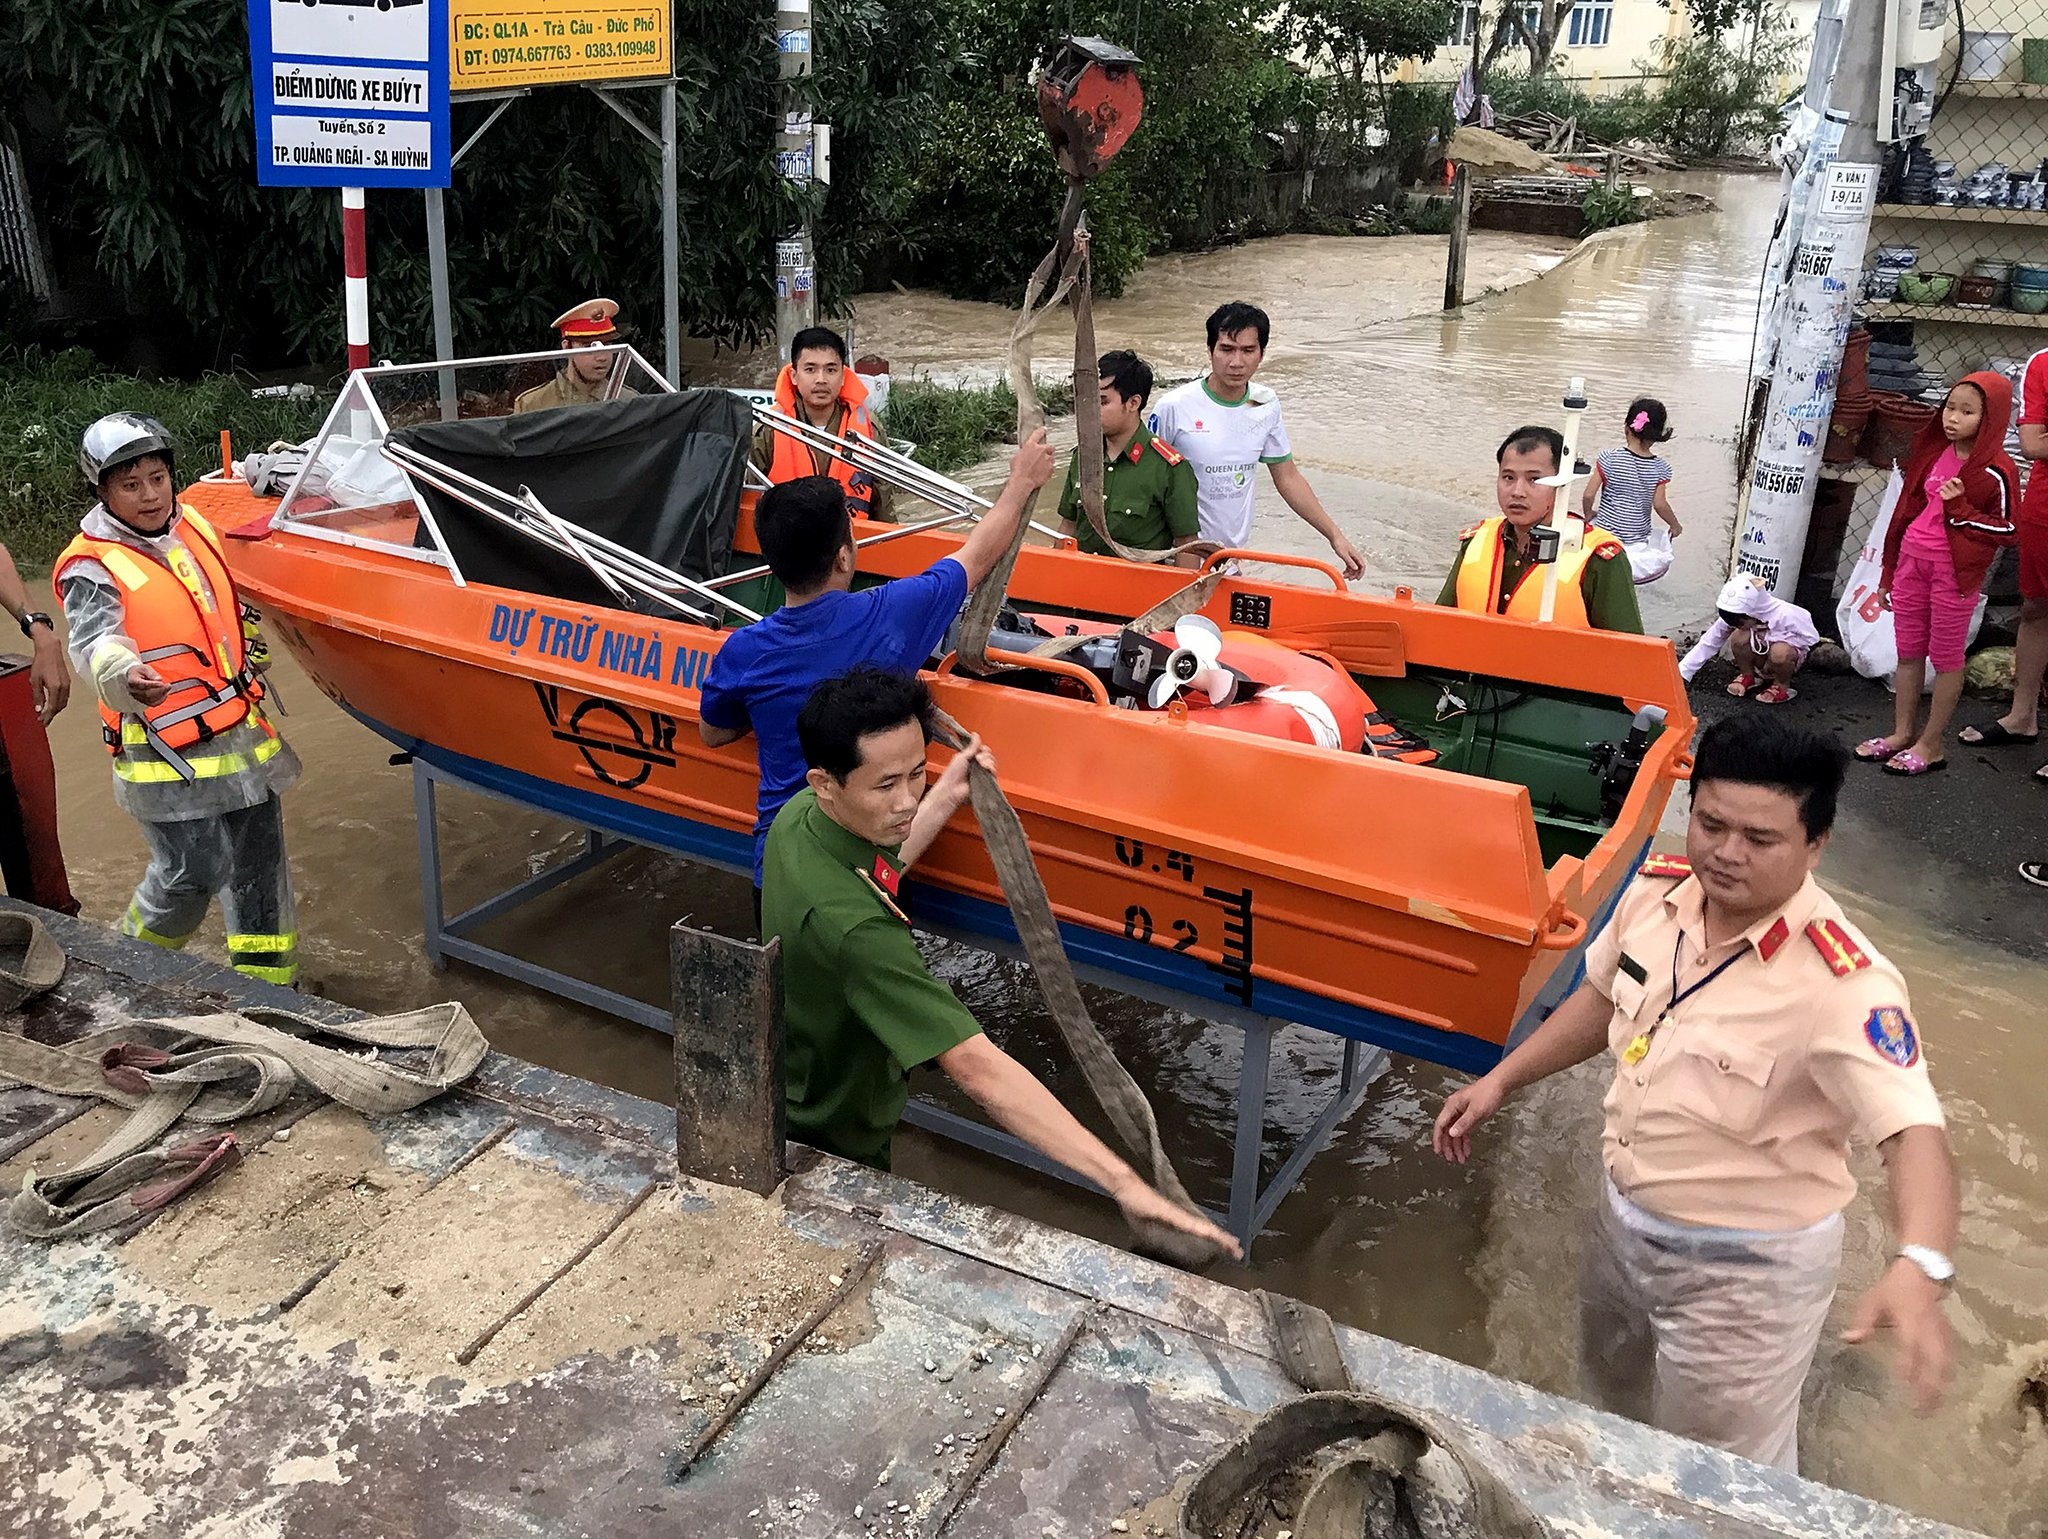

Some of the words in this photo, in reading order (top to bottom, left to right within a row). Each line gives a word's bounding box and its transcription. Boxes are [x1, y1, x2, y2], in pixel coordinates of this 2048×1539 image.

[493, 22, 529, 39] QL1A
[543, 20, 565, 36] Trà
[570, 19, 593, 35] Câu
[606, 17, 629, 33] Đức
[634, 13, 655, 31] Phổ
[492, 45, 571, 64] 0974.667763
[585, 40, 656, 58] 0383.109948
[275, 68, 313, 98] ĐIỂM
[315, 73, 357, 101] DỪNG
[362, 80, 381, 102] XE
[383, 77, 422, 104] BUÝT
[318, 119, 354, 135] Tuyến
[358, 121, 374, 134] Số
[378, 123, 386, 135] 2
[274, 145, 290, 162] TP.
[293, 141, 333, 164] QUẢNG
[336, 145, 363, 165] NGÃI
[374, 150, 388, 166] SA
[391, 147, 428, 168] HUỲNH
[1205, 464, 1233, 474] QUEEN
[489, 604, 536, 656] DỰ
[538, 615, 599, 663] TRỮ
[598, 630, 662, 681] NHÀ
